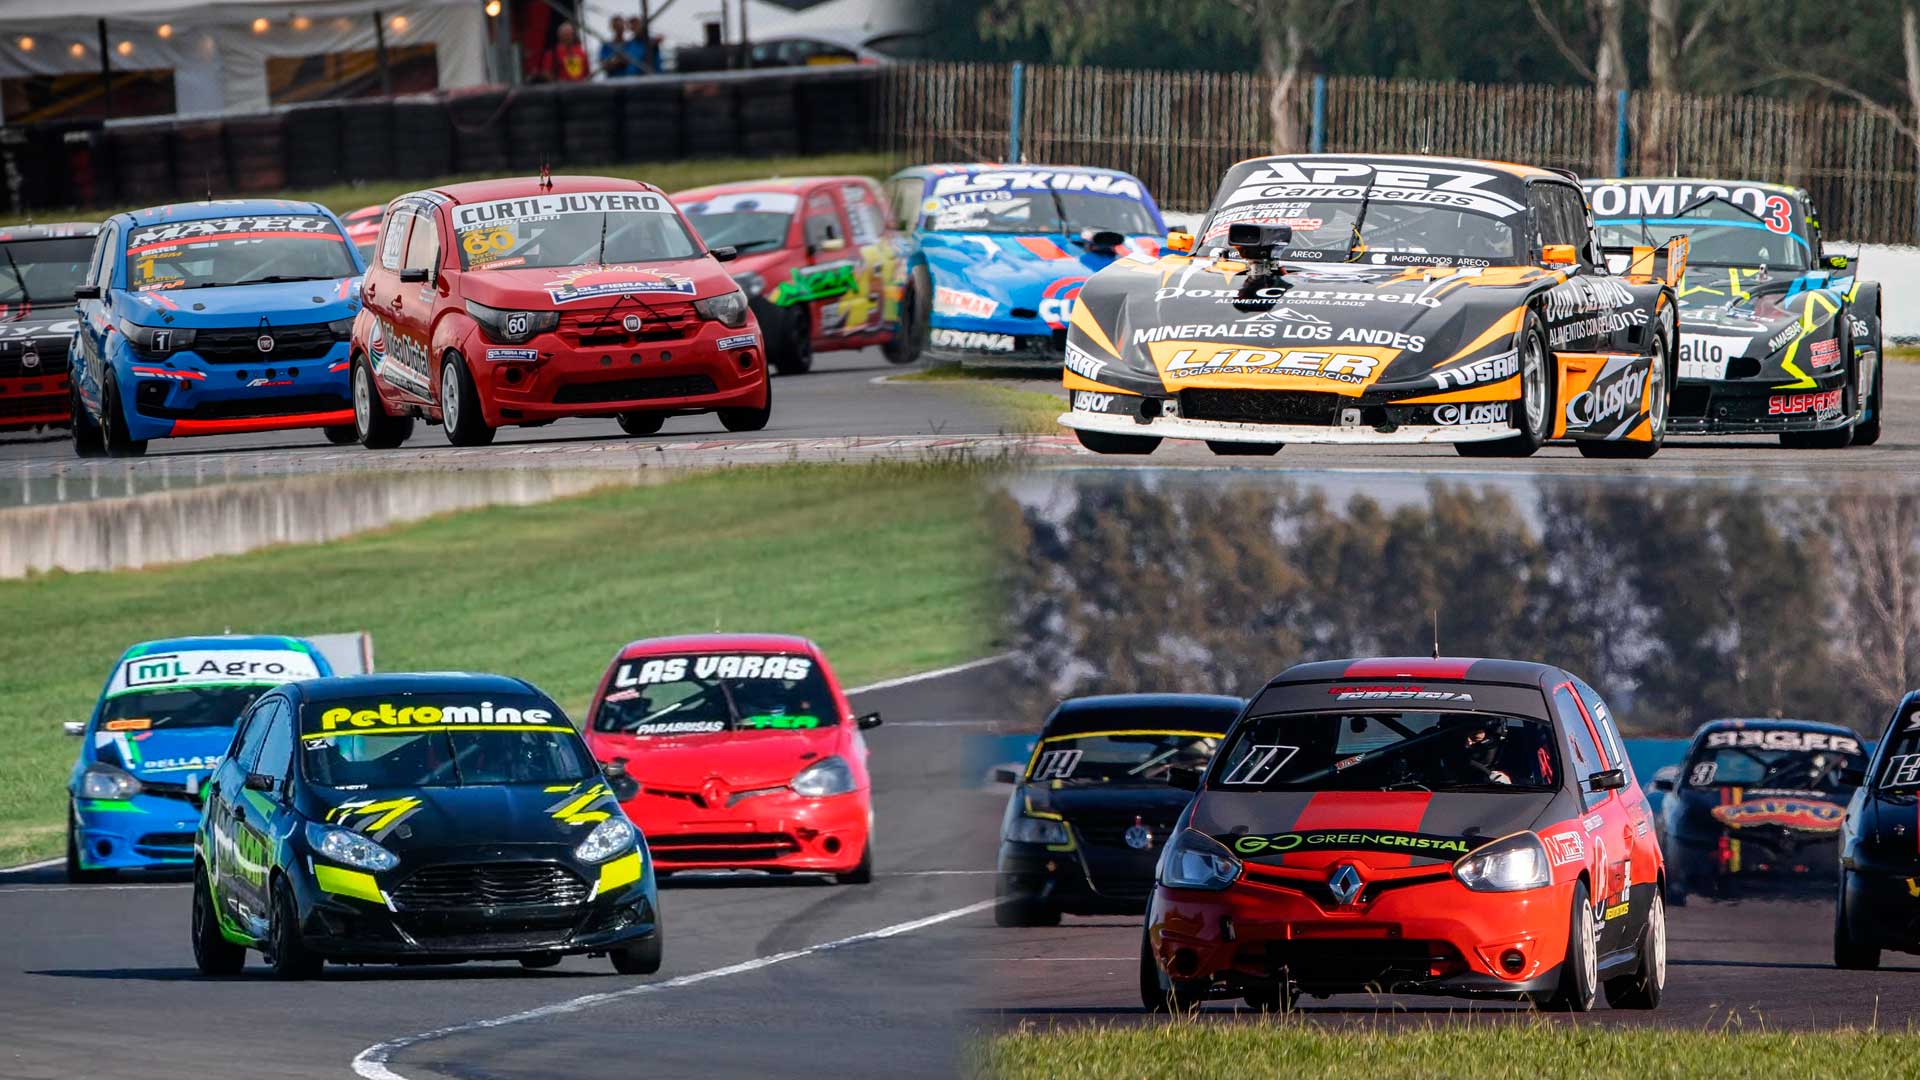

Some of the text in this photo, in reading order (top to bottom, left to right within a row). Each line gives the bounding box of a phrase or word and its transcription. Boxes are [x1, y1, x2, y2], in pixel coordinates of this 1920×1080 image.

[1239, 162, 1498, 190] APEZ
[460, 195, 660, 224] CURTI-JUYERO
[1765, 196, 1793, 235] 3
[130, 219, 331, 246] MATEU
[458, 215, 560, 234] JUYERO/CURTI
[463, 231, 515, 254] 60
[1291, 251, 1323, 259] ARECO
[1391, 255, 1490, 268] IMPORTADOS ARECO
[136, 259, 154, 279] 1
[1256, 287, 1441, 308] Carmelo
[508, 318, 526, 334] 60
[1132, 323, 1426, 353] MINERALES LOS ANDES
[1246, 367, 1255, 375] Y
[195, 659, 285, 676] Agro
[615, 657, 689, 688] LAS
